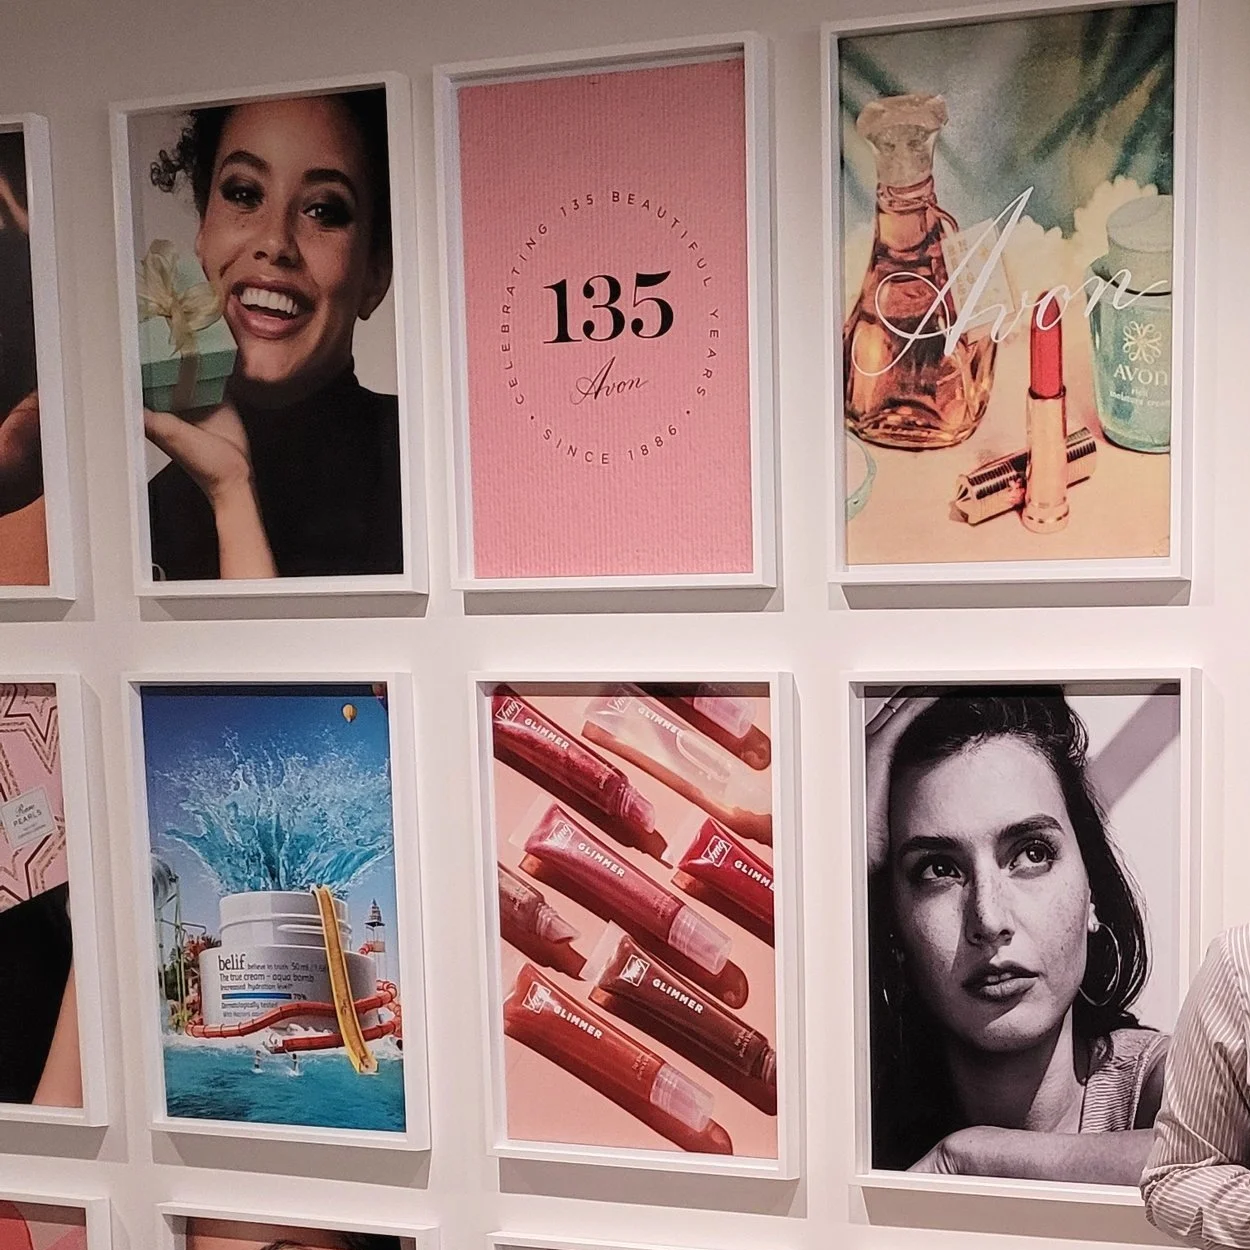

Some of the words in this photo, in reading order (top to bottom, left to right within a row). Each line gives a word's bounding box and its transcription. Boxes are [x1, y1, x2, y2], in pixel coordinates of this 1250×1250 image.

[501, 223, 548, 405] CELEBRATING
[560, 194, 594, 217] 135
[611, 191, 712, 288] BEAUTIFUL
[696, 308, 719, 396] YEARS
[851, 186, 1168, 376] Avon
[543, 271, 674, 344] 135
[570, 356, 649, 405] Avon
[543, 428, 609, 464] SINCE
[628, 424, 677, 461] 1886
[524, 717, 571, 750] GLIMMER
[13, 809, 42, 827] PEARLS
[577, 842, 625, 878] GLIMMER
[218, 954, 246, 971] belif
[219, 973, 229, 981] The
[230, 973, 242, 981] true
[272, 974, 291, 982] aqua
[293, 974, 314, 982] bomb
[652, 978, 703, 1014] GLIMMER
[553, 1005, 603, 1039] GLIMMER
